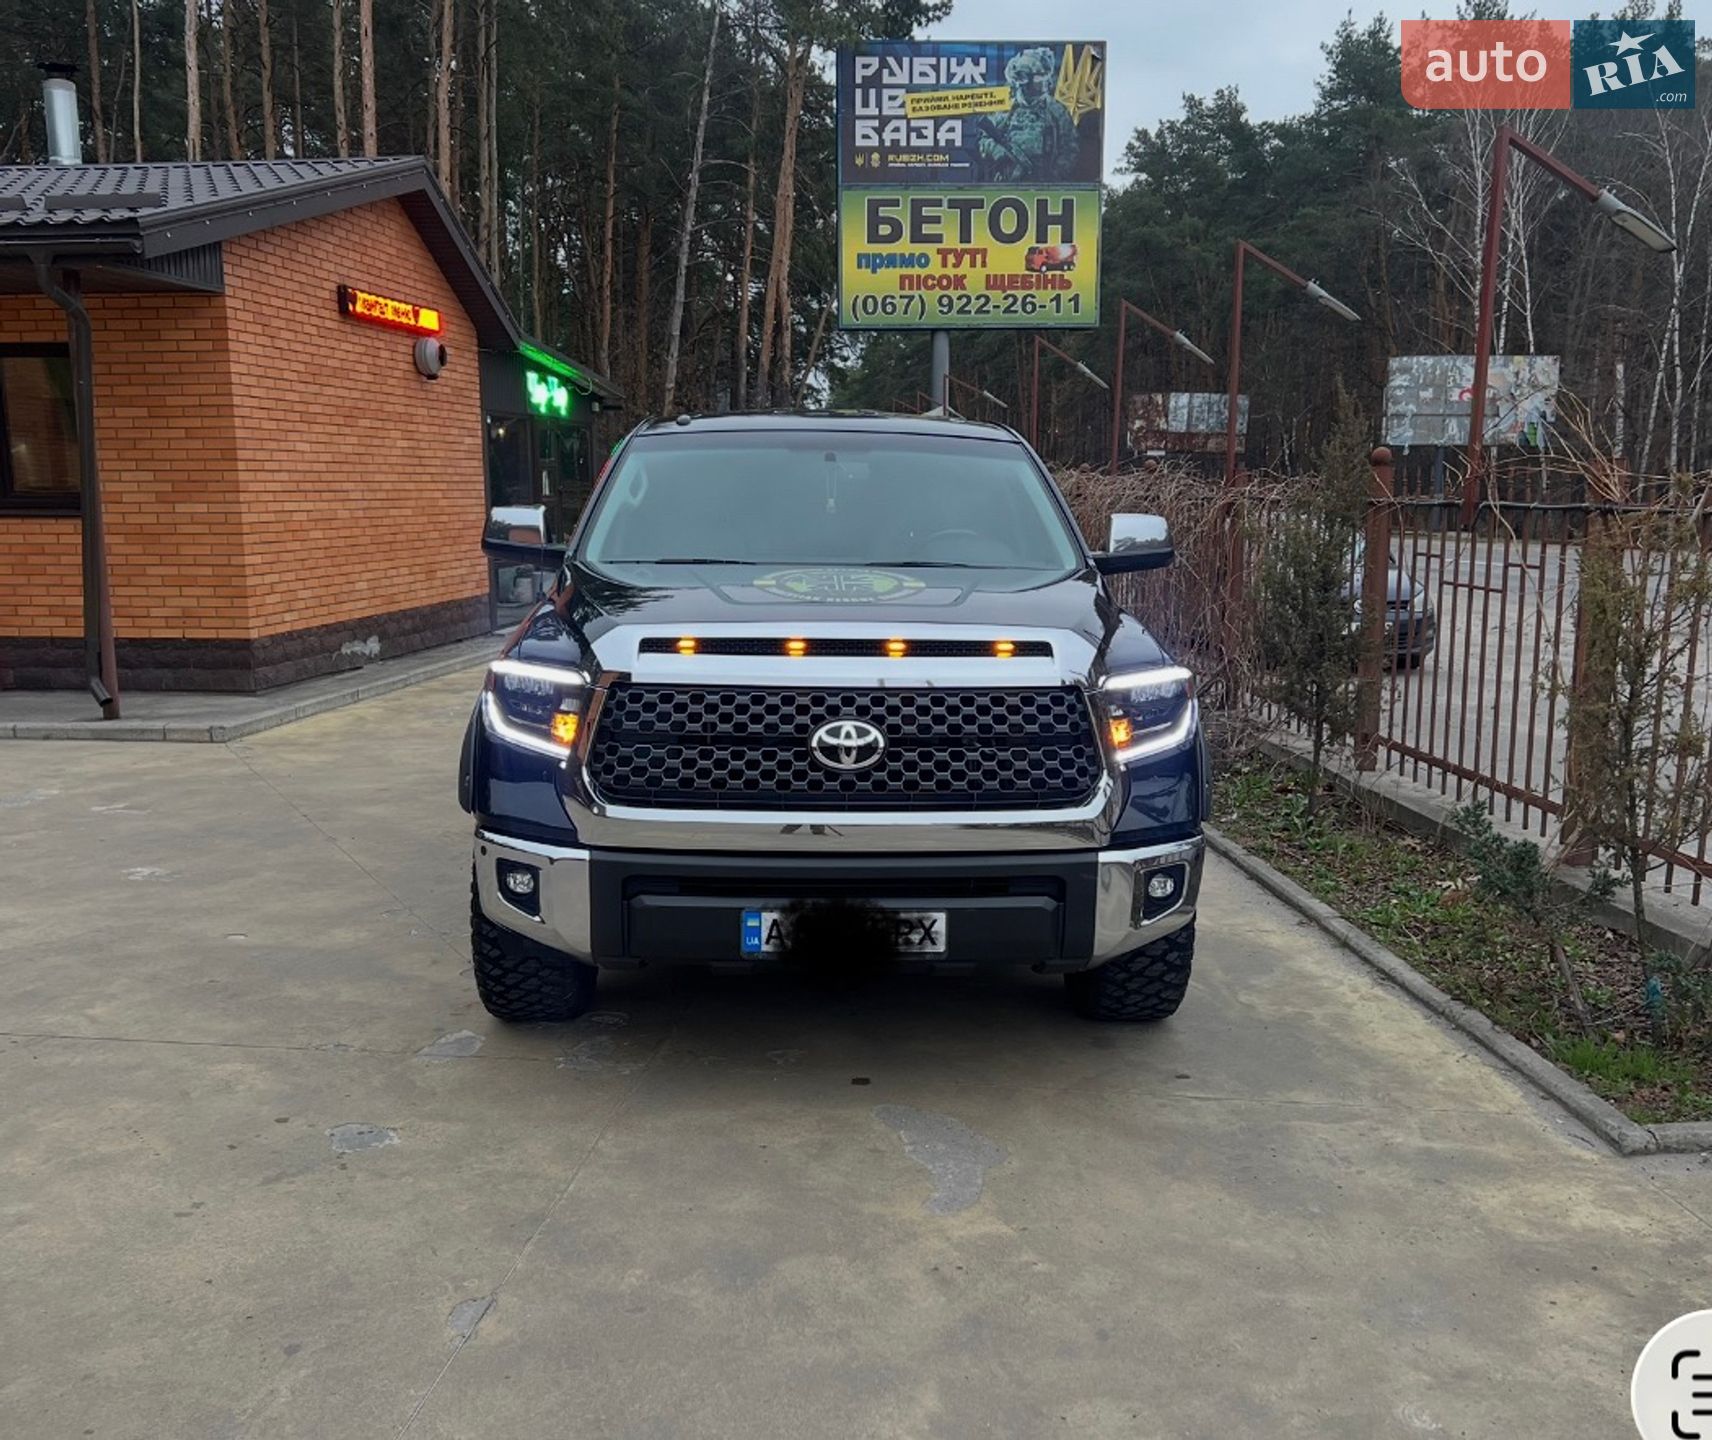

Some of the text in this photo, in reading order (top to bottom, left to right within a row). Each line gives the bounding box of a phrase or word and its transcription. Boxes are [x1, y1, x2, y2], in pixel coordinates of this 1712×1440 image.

[855, 56, 987, 84] РУБІЖ
[855, 88, 908, 116] ЦЕ
[855, 119, 963, 147] БАЗА
[866, 197, 1076, 245] БЕТОН
[856, 247, 988, 275] прямо ТУТ!
[899, 273, 1073, 294] ПІСОК ЩЕБІНЬ
[851, 293, 1081, 323] (067) 922-26-11
[746, 936, 760, 946] UA
